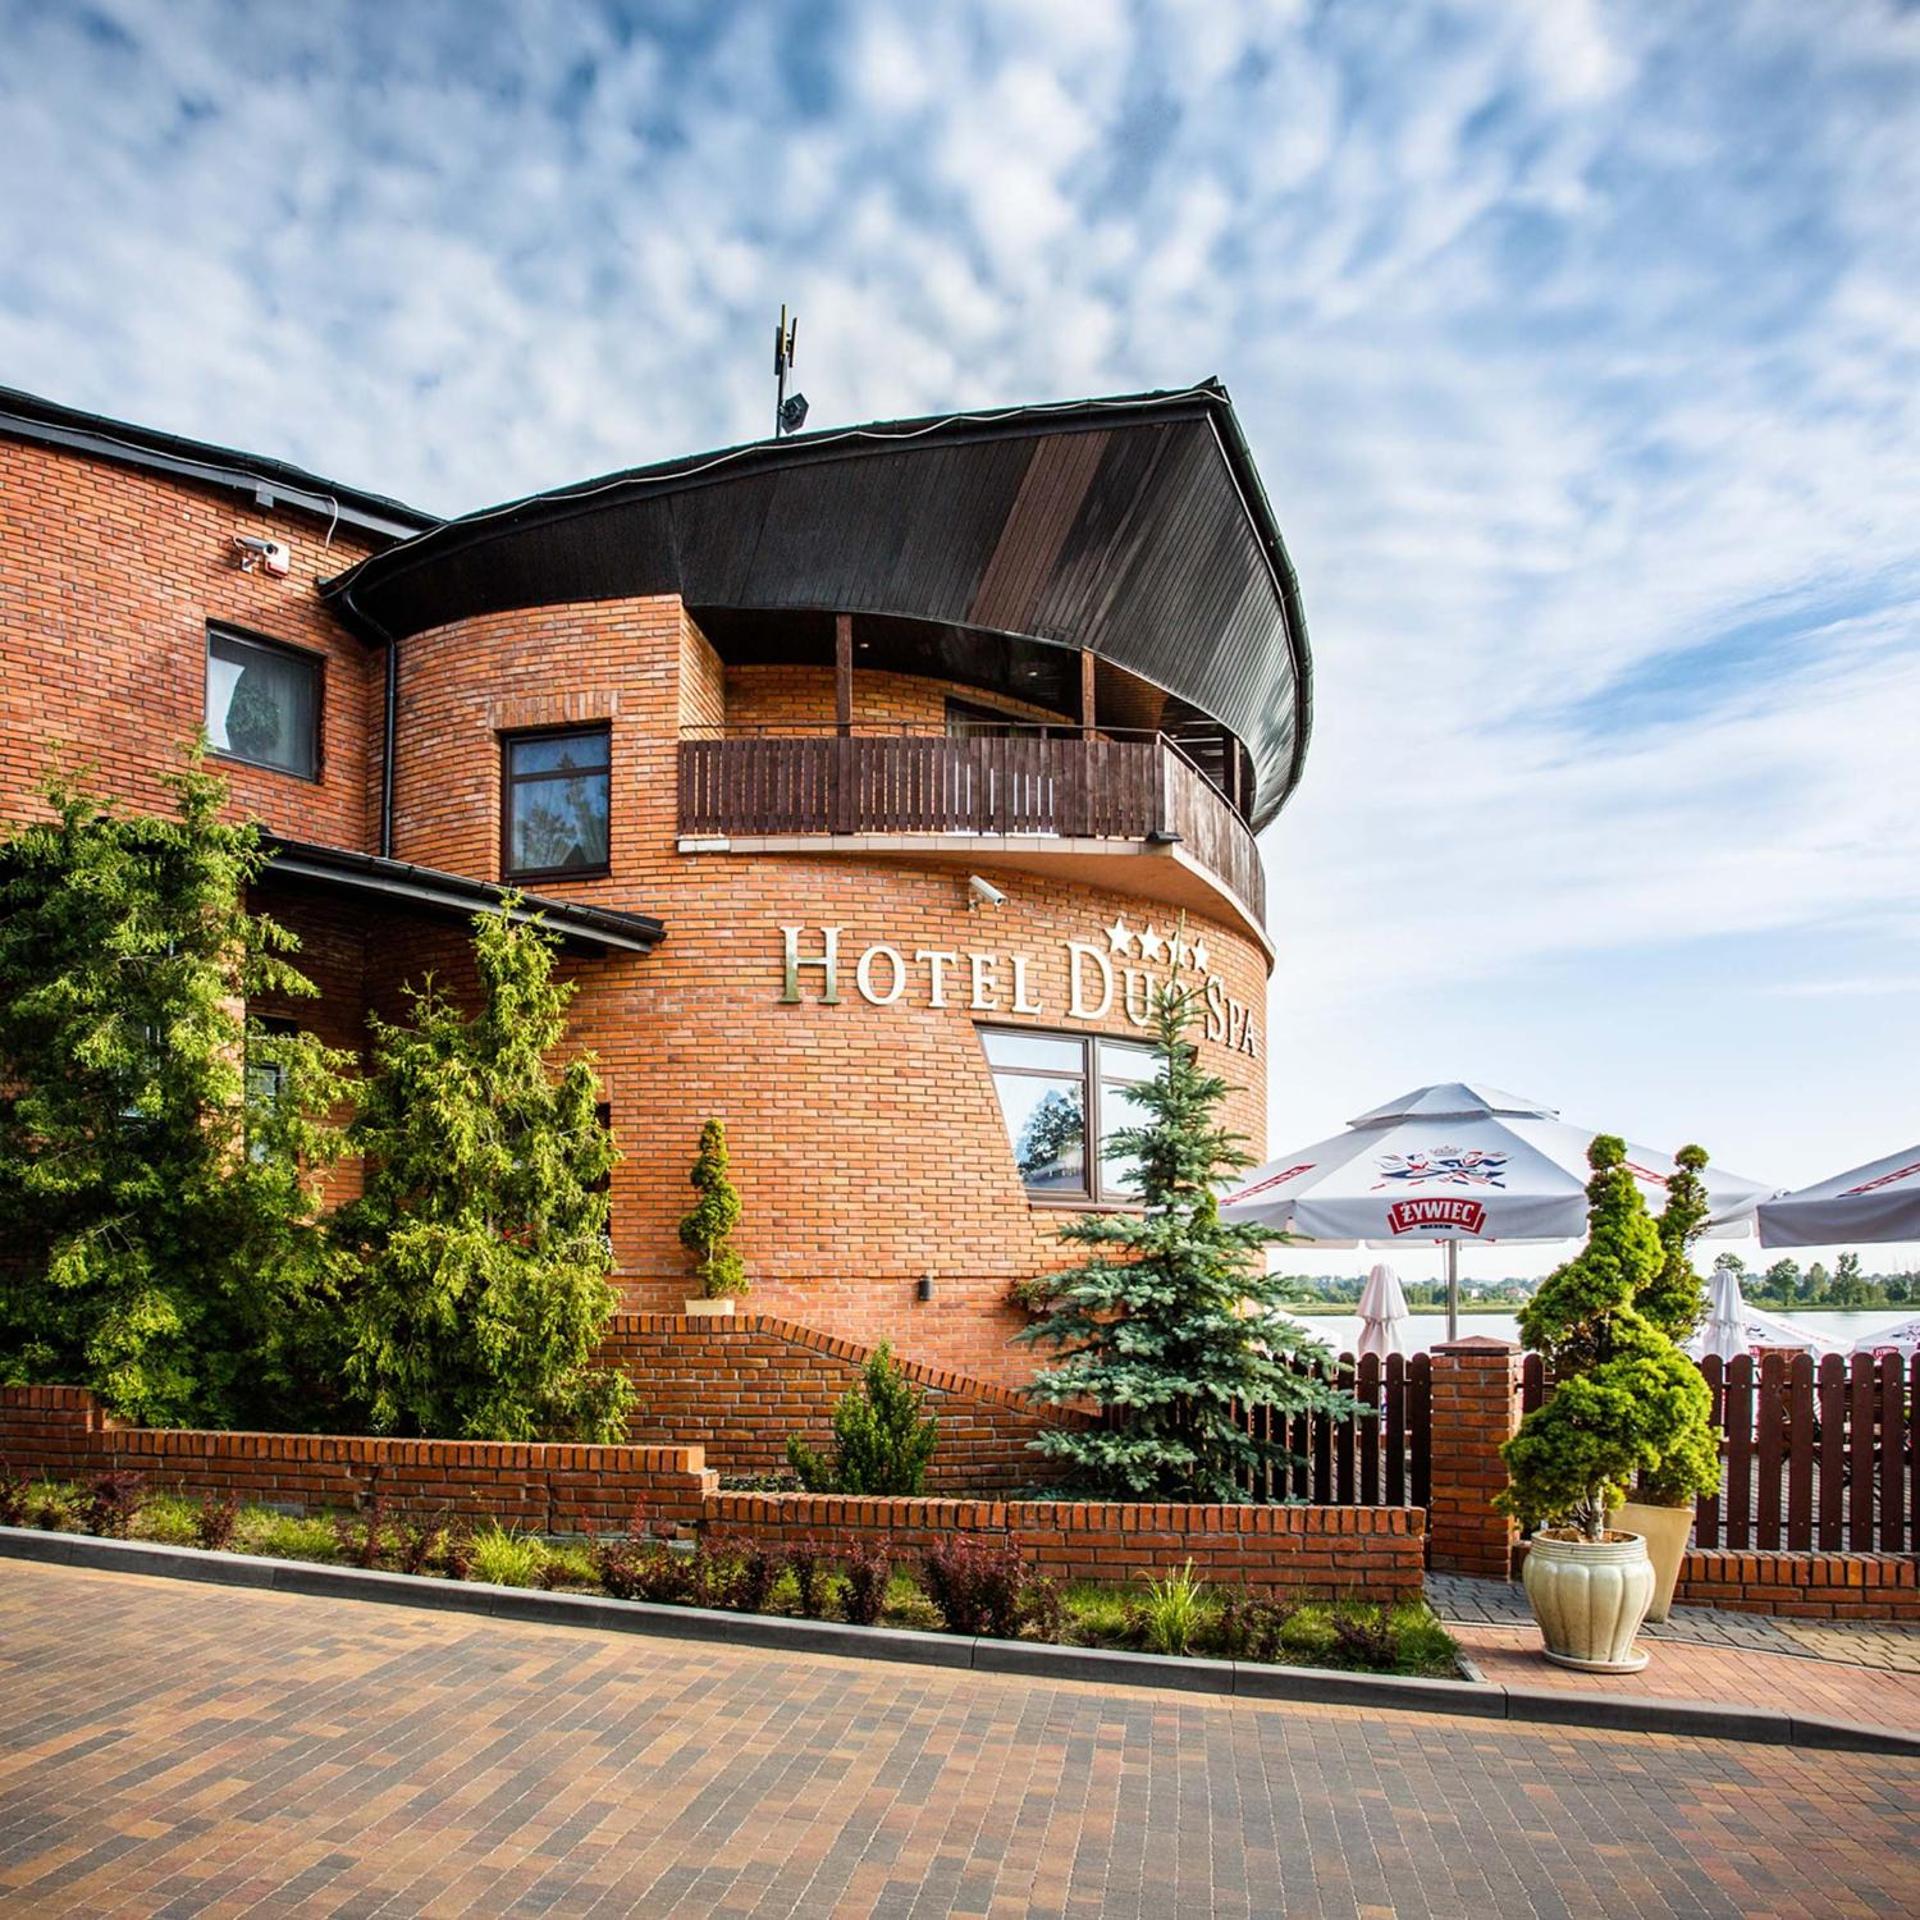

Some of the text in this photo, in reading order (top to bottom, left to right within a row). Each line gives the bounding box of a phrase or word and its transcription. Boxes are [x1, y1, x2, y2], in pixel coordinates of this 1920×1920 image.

[779, 926, 1042, 1015] HOTEL
[1204, 974, 1258, 1058] SPA
[1400, 1200, 1474, 1223] ŻYWIEC
